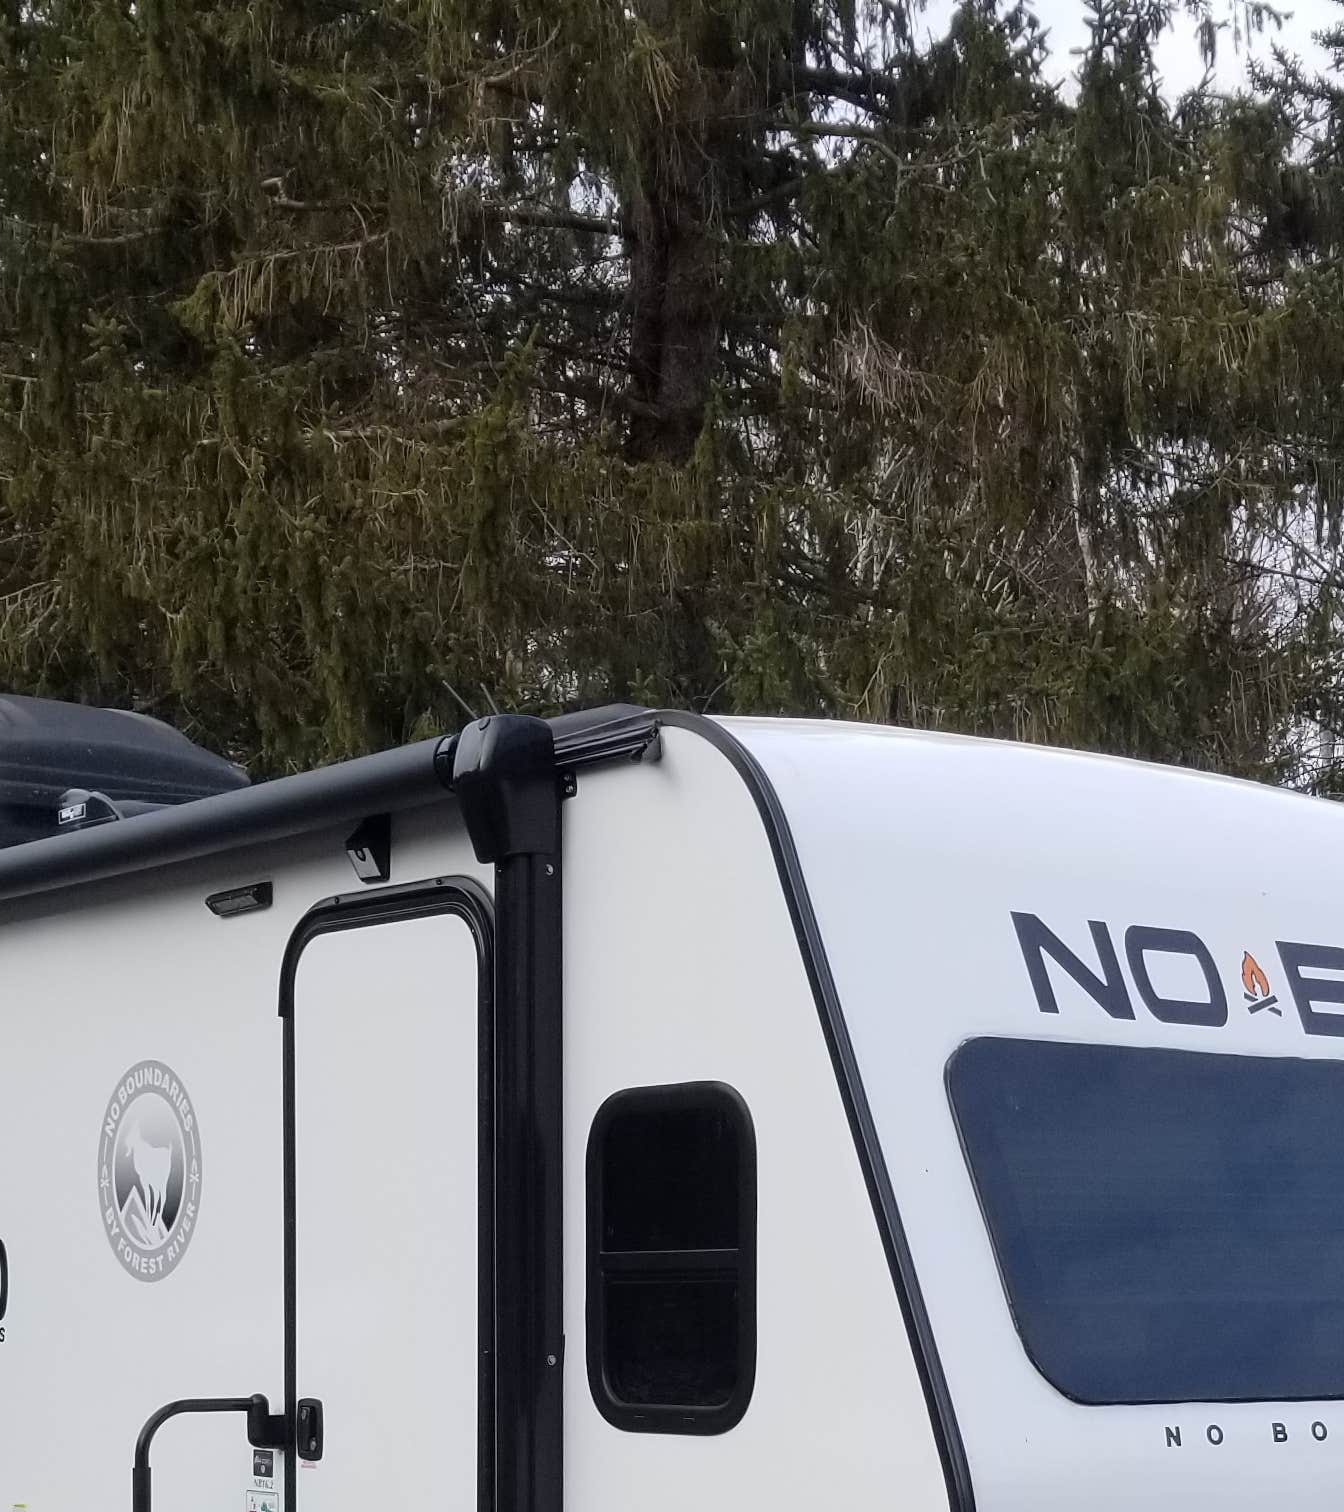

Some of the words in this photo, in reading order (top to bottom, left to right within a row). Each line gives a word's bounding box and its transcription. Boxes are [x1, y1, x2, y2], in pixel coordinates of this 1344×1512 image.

[1010, 911, 1229, 1028] NO
[105, 1103, 121, 1138] NO
[118, 1067, 194, 1132] BOUNDARIES
[105, 1205, 120, 1236] BY
[117, 1237, 165, 1275] FOREST
[168, 1204, 196, 1263] RIVER
[1164, 1424, 1224, 1448] NO
